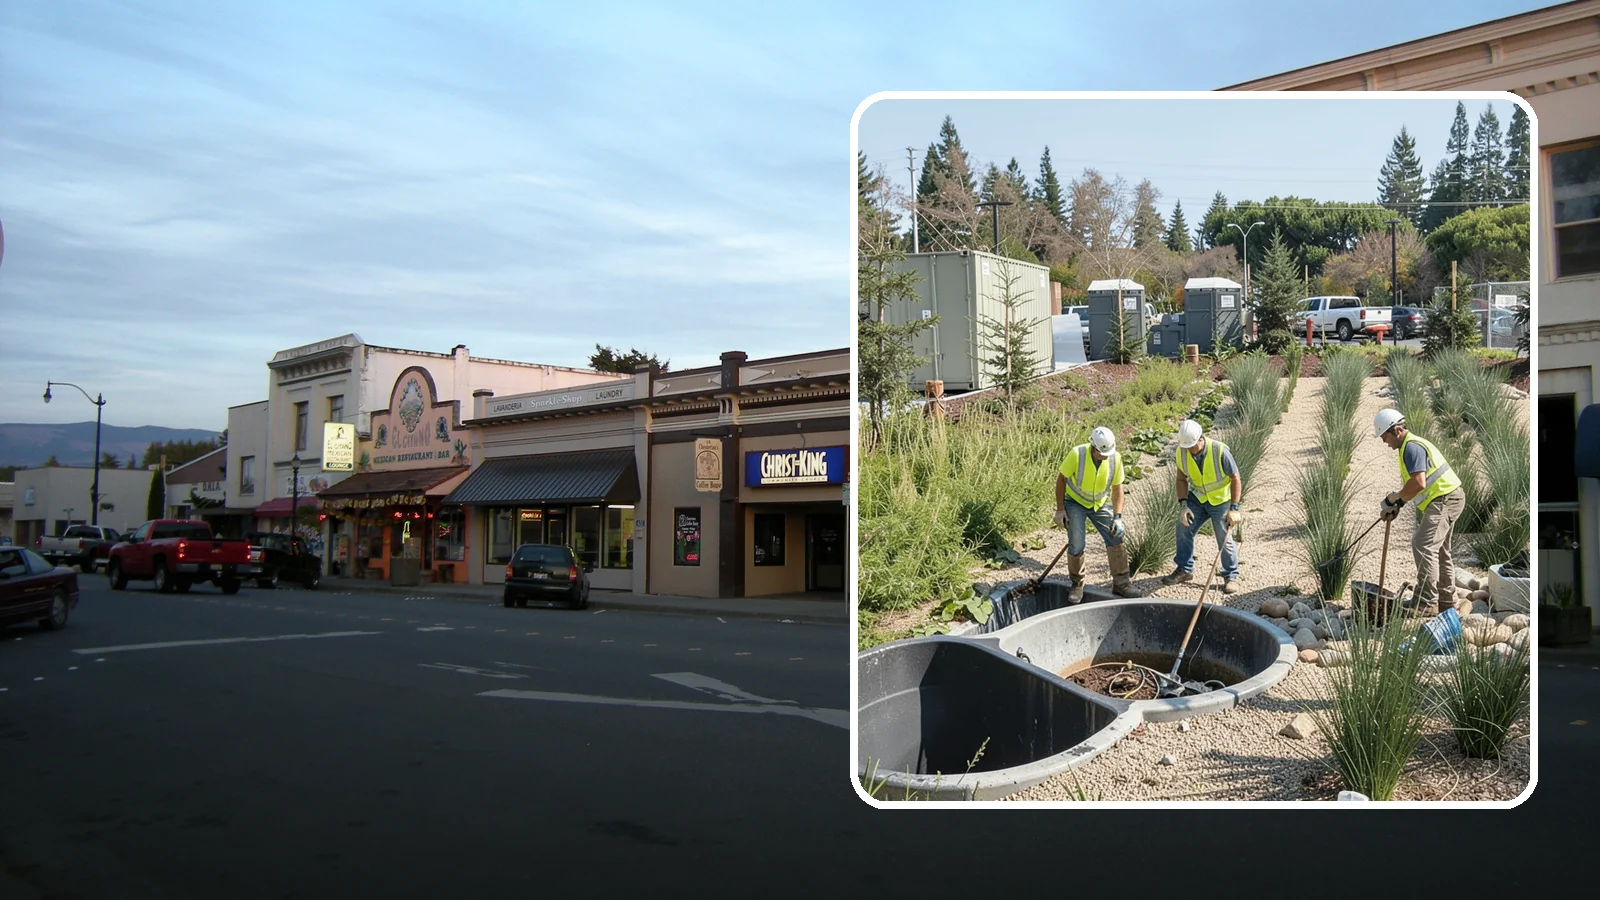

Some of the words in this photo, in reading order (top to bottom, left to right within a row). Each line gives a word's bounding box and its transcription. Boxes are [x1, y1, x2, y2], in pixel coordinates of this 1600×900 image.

[562, 394, 582, 405] Shop
[595, 388, 624, 400] LAUNDRY
[493, 402, 523, 412] LAVANDERIA
[374, 456, 396, 464] MEXICAN
[398, 452, 433, 462] RESTAURANT
[438, 450, 450, 458] BAR
[761, 452, 796, 478] CHRIST
[799, 450, 827, 476] KING
